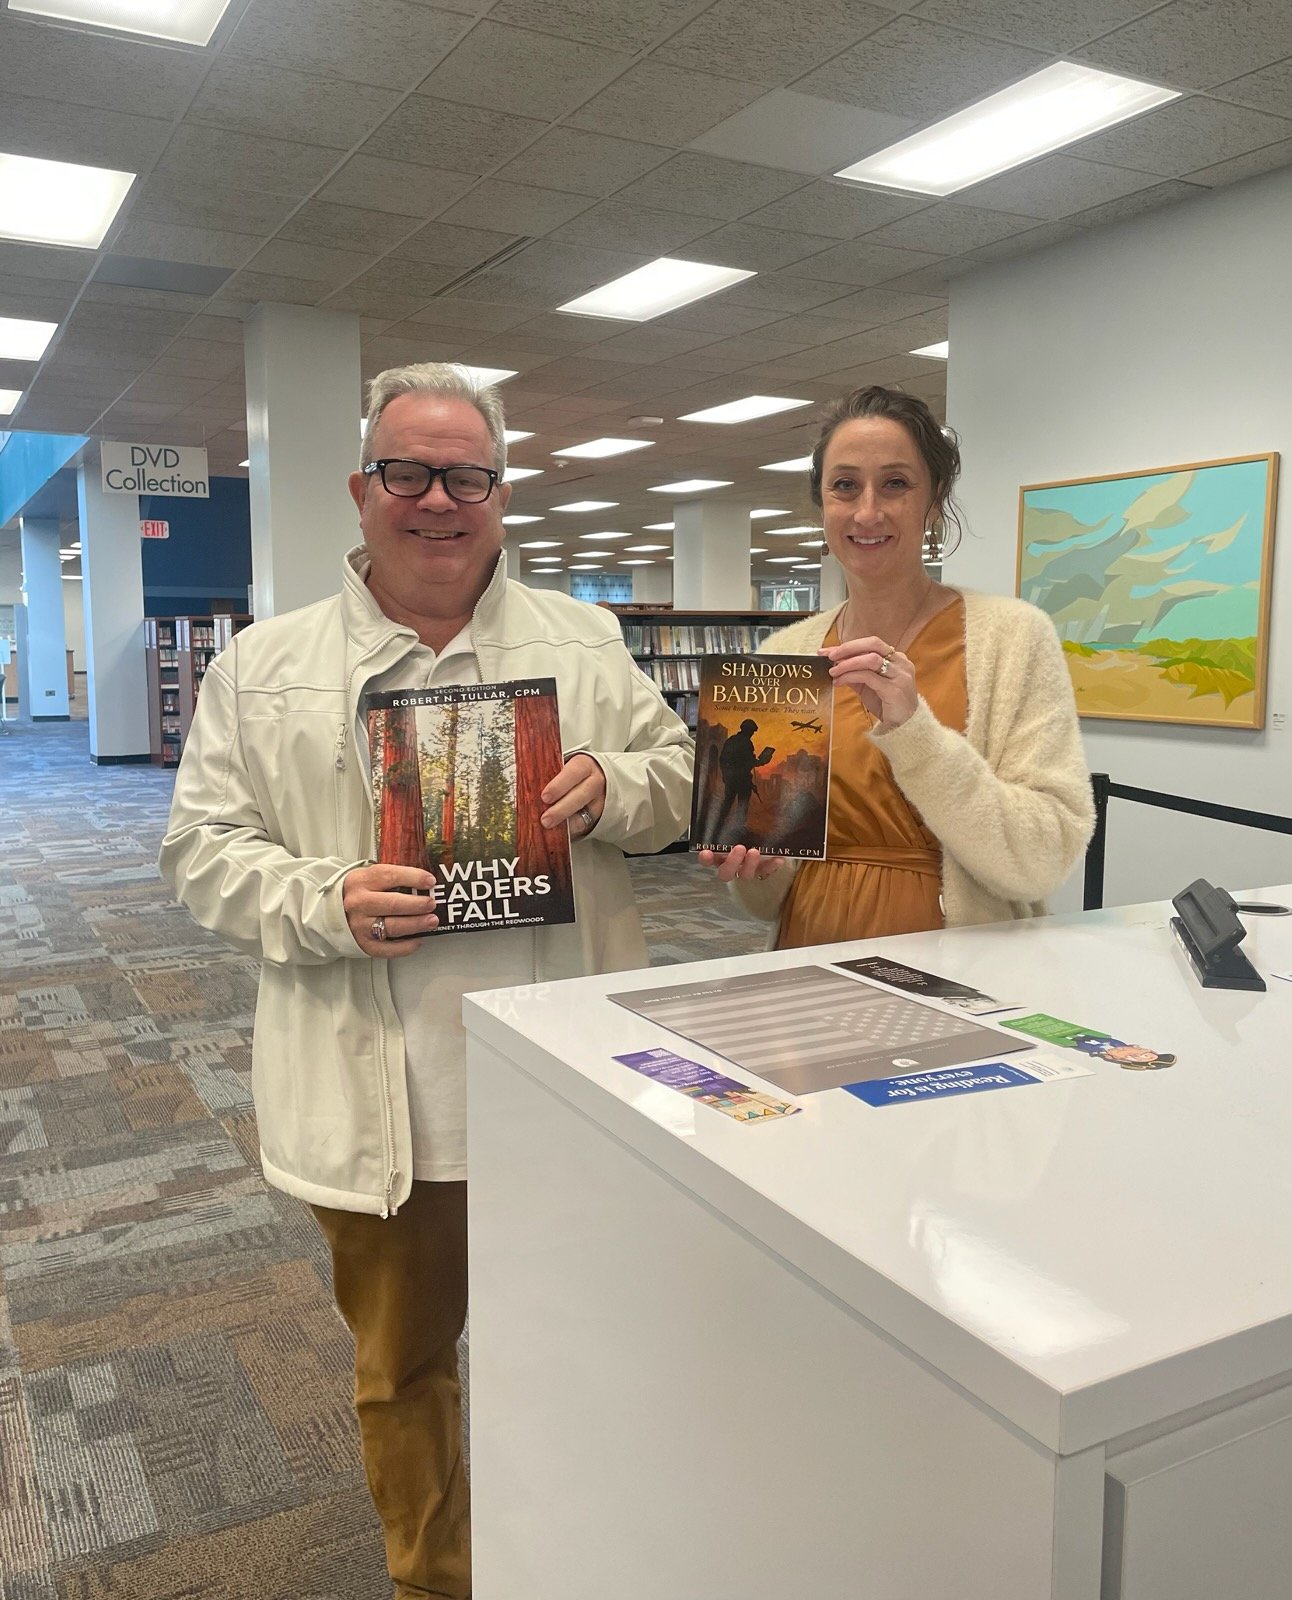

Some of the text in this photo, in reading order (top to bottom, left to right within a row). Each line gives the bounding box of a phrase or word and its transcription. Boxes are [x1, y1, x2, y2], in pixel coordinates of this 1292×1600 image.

[131, 446, 180, 468] DVD
[106, 468, 206, 494] Collection
[144, 521, 165, 537] EXIT
[721, 662, 813, 679] SHADOWS
[434, 687, 465, 695] SECOND
[752, 677, 780, 687] OVER
[392, 688, 541, 707] ROBERT N. TULLAR, CPM
[713, 684, 820, 705] BABYLON
[753, 846, 794, 855] ULLAR,
[799, 848, 820, 856] CPM
[438, 856, 521, 883] WHY
[412, 874, 551, 905] EADERS
[447, 898, 520, 924] FALL
[456, 921, 490, 929] THROUGH
[505, 916, 545, 925] REDWOODS
[887, 1074, 1012, 1097] Reading is for
[889, 1070, 974, 1086] everyone.
